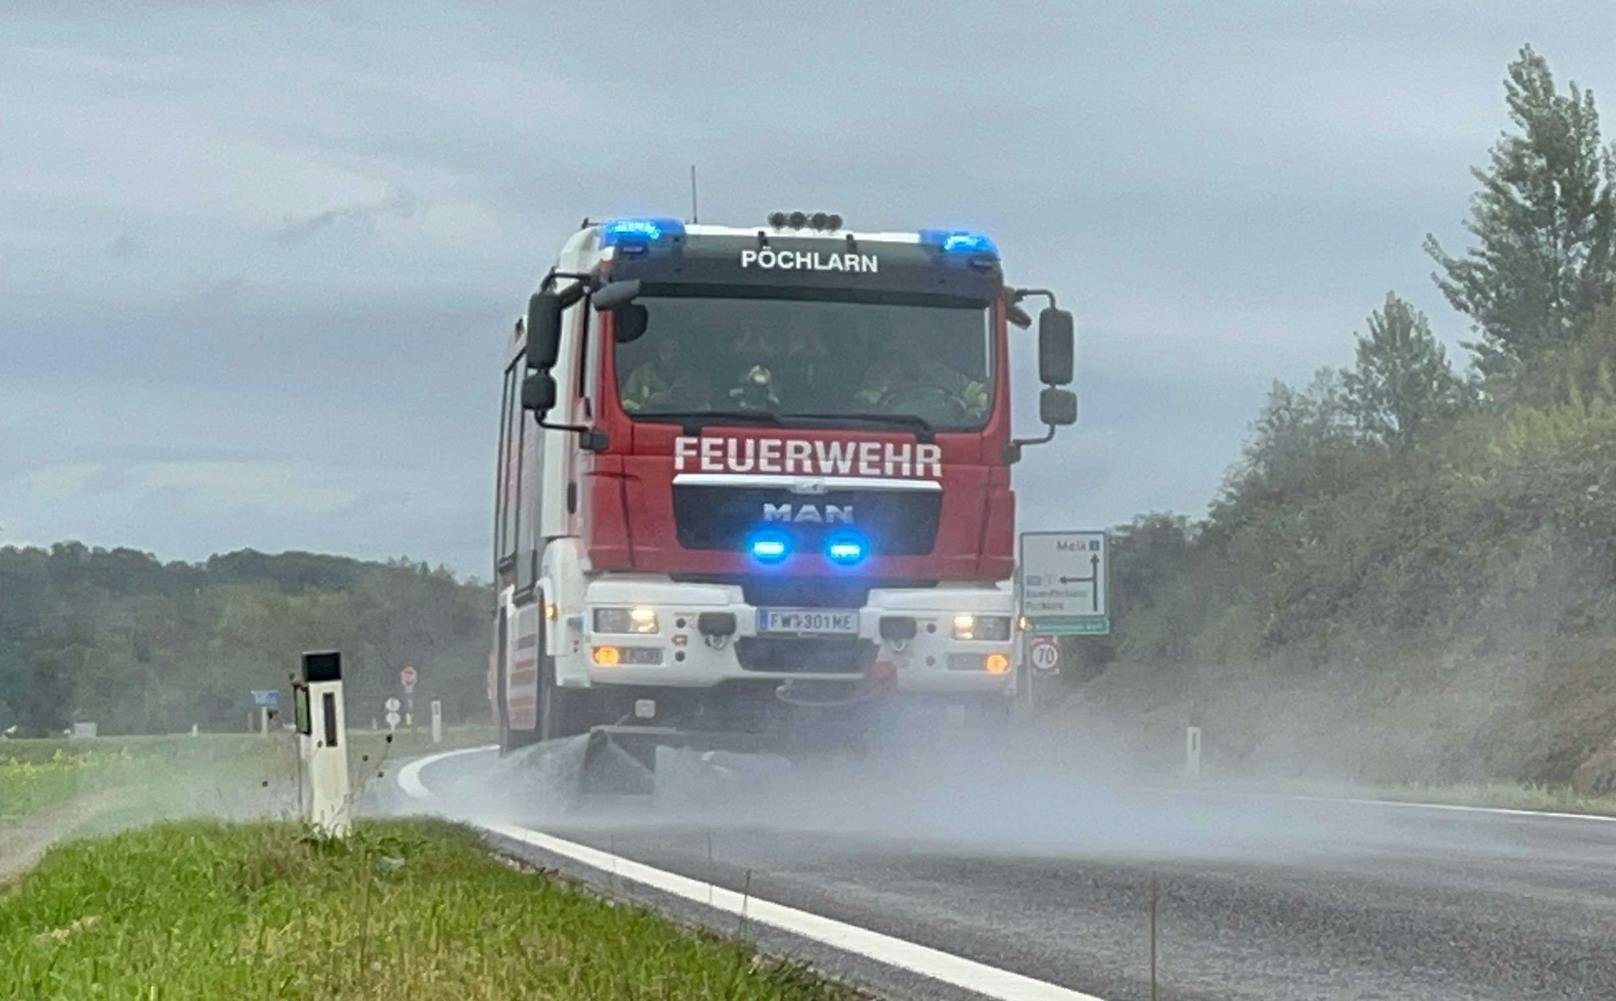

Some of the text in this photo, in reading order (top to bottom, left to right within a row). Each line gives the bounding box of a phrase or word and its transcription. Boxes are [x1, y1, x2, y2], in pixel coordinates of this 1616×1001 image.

[741, 246, 878, 273] PÖCHLARN
[674, 436, 943, 477] FEUERWEHR
[763, 503, 854, 524] MAN
[1039, 647, 1055, 665] 70
